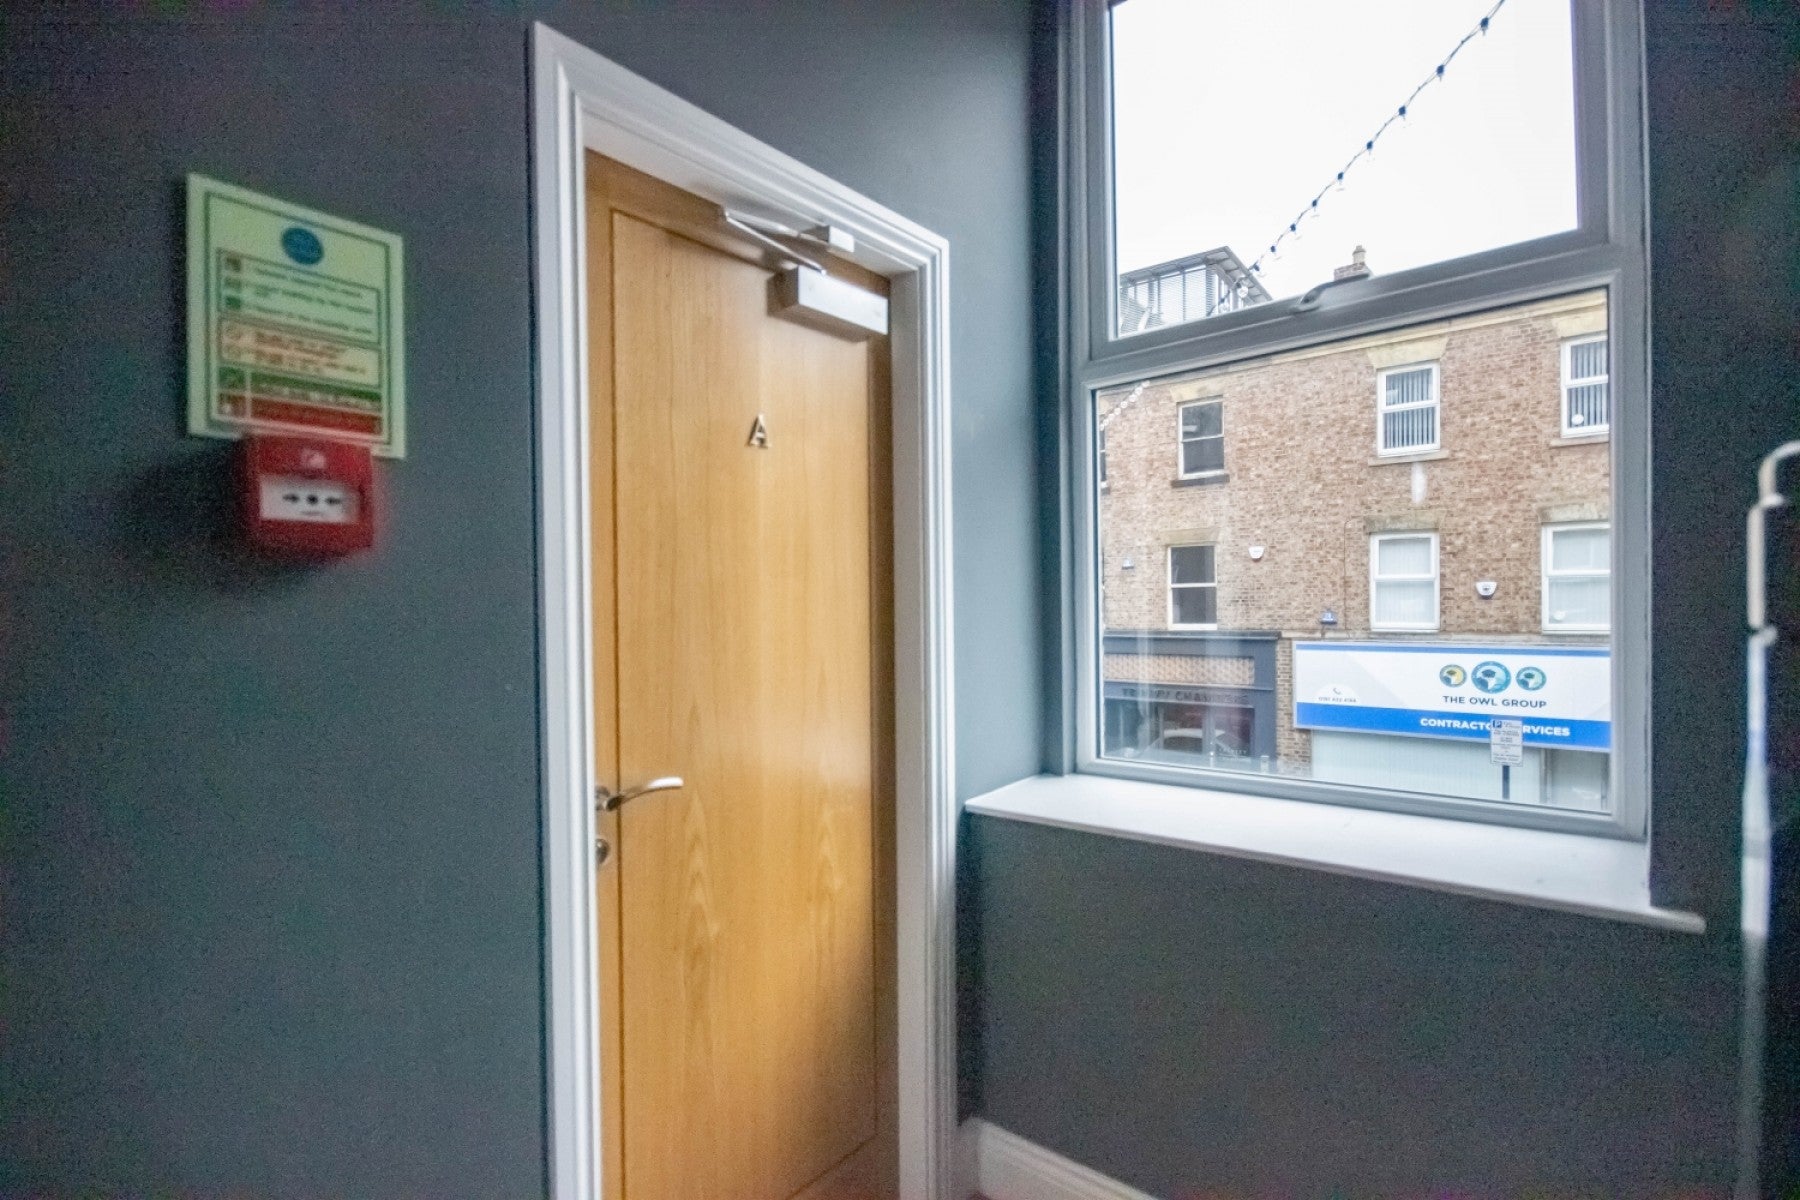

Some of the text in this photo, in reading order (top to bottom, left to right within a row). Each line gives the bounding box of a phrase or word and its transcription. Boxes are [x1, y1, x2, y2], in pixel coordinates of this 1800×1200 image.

[745, 413, 772, 450] A
[1442, 695, 1547, 708] THE OWL GROUP
[1522, 725, 1571, 737] RVICES
